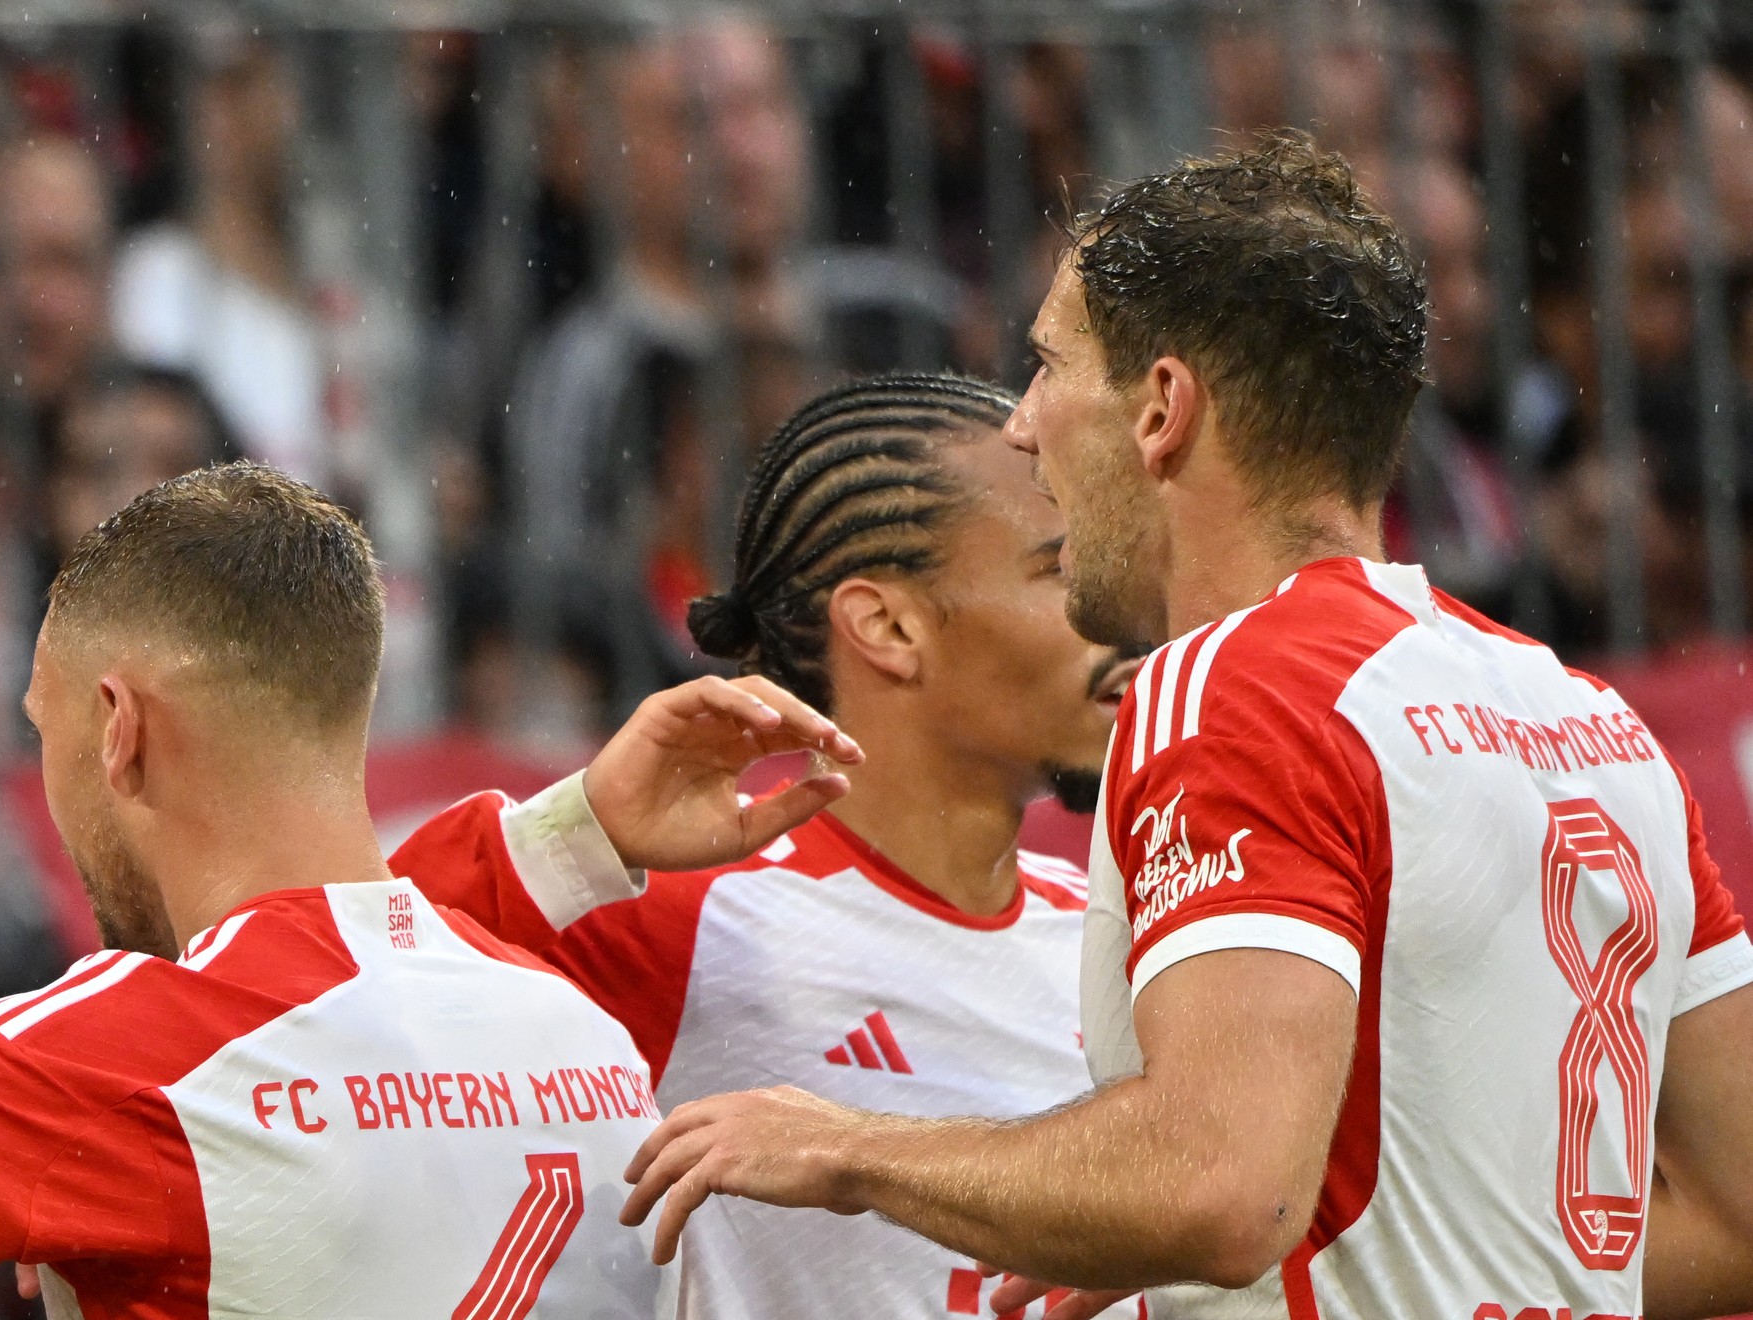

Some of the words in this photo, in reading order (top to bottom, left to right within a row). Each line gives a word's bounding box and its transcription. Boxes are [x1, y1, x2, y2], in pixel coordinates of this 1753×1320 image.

[1404, 703, 1463, 756] FC
[388, 893, 412, 911] MIA
[388, 913, 413, 931] SAN
[389, 932, 416, 949] MIA
[1541, 798, 1658, 1271] 8
[251, 1078, 328, 1135] FC
[343, 1071, 520, 1130] BAYERN
